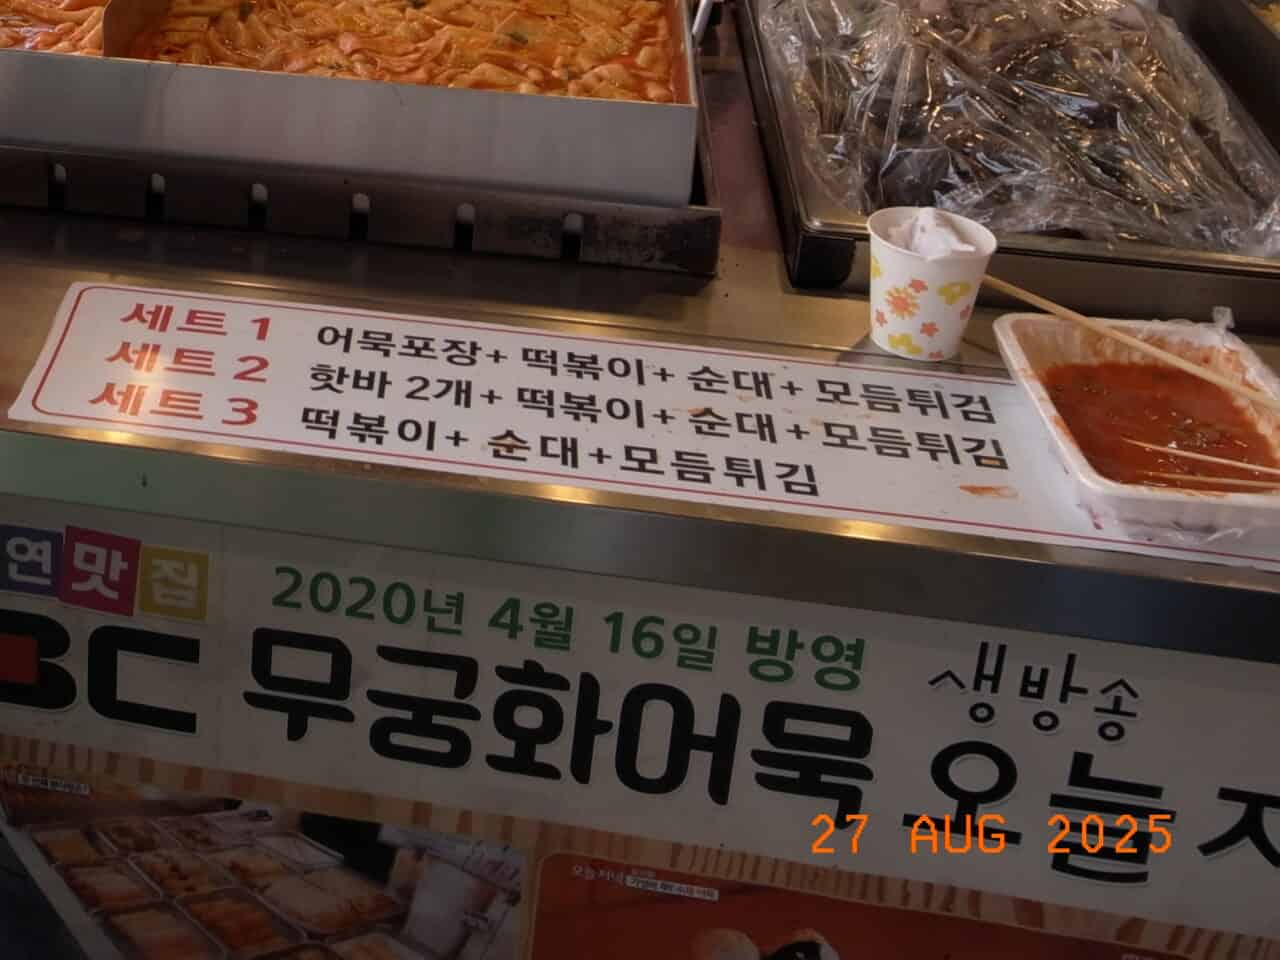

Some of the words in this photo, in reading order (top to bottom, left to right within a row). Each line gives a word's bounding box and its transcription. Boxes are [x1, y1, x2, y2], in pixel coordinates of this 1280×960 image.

[119, 302, 229, 336] 세트
[250, 316, 273, 341] 1
[88, 381, 206, 420] 세트
[221, 397, 261, 427] 3
[104, 340, 217, 377] 세트
[233, 355, 270, 383] 2
[309, 362, 393, 399] 핫바
[821, 421, 1010, 471] 모듬튀김
[271, 565, 465, 636] 2020년
[488, 596, 575, 652] 4월
[602, 610, 718, 673] 16일
[745, 624, 866, 692] 방영
[928, 640, 1139, 742] 생방송
[242, 626, 875, 831] 무궁화어묵
[902, 740, 1177, 884] 오늘
